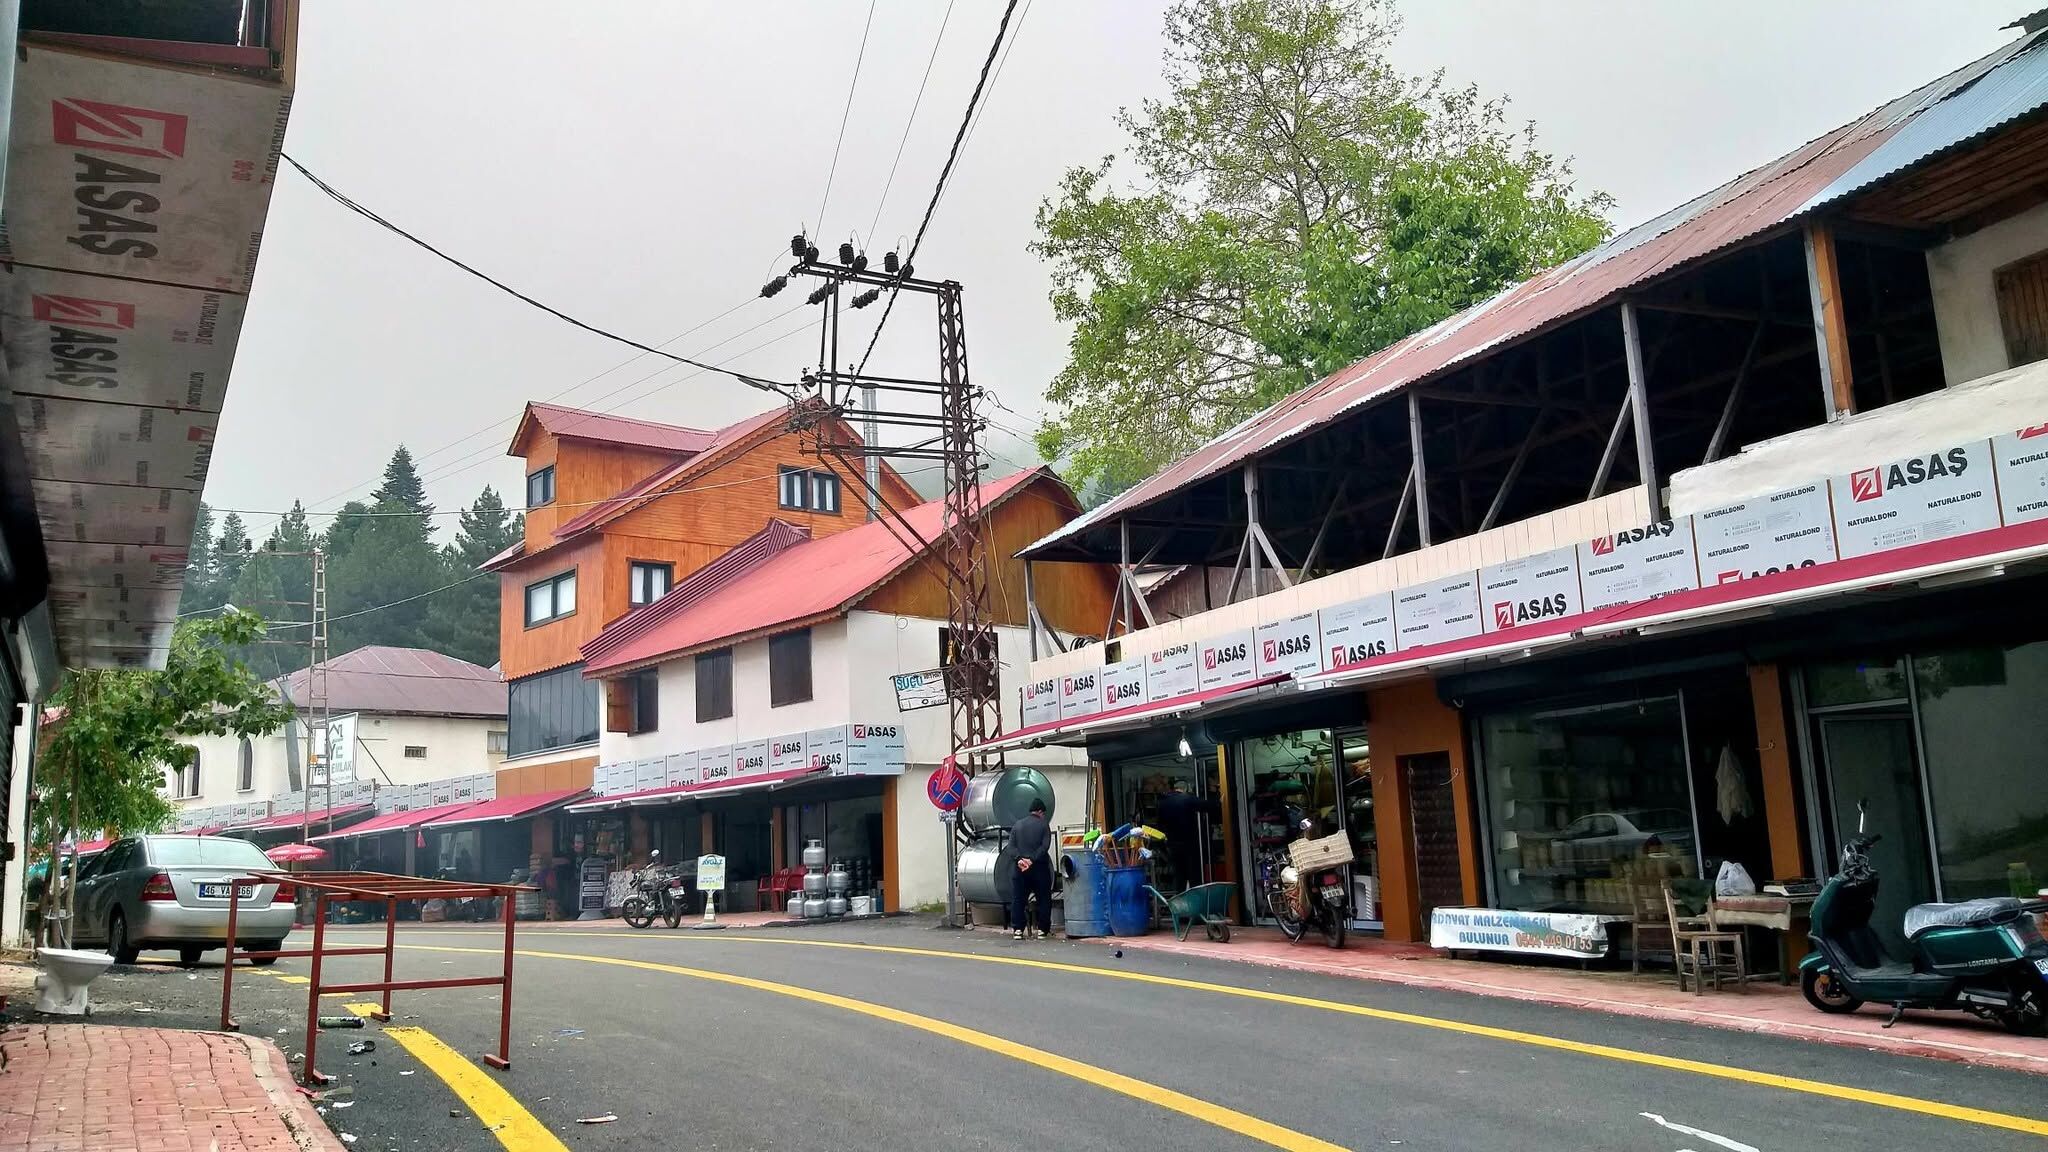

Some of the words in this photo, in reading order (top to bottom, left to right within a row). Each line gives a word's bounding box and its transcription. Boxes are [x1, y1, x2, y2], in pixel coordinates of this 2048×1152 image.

[67, 153, 161, 259] ASAŞ
[46, 326, 119, 389] ASAŞ
[1887, 447, 1968, 490] ASAŞ
[1770, 485, 1816, 503] NATURALBOND
[1927, 491, 1982, 509] NATURALBOND
[1703, 504, 1746, 519] NATURALBOND
[1847, 510, 1898, 527] NATURALBOND
[1774, 526, 1821, 543] NATURALBOND
[1645, 549, 1684, 564] NATURALBOND
[1707, 544, 1750, 558] NATURALBOND
[1535, 566, 1569, 579] NATURALBOND
[1588, 563, 1625, 577] NATURALBOND
[1487, 578, 1518, 590] NATURALBOND
[1517, 593, 1567, 622] ASAŞ
[1217, 643, 1246, 665] ASAŞ
[1278, 634, 1311, 657] ASAŞ
[1035, 679, 1054, 695] ASAŞ
[1073, 675, 1095, 692] ASAŞ
[1117, 681, 1140, 700] ASAŞ
[867, 726, 897, 738] ASAŞ
[781, 741, 801, 754] ASAŞ
[745, 756, 763, 768] ASAŞ
[205, 886, 215, 895] 46
[1459, 931, 1510, 946] BULUNUR
[1543, 934, 1563, 949] 449
[1565, 935, 1577, 949] 01
[1579, 936, 1593, 951] 53
